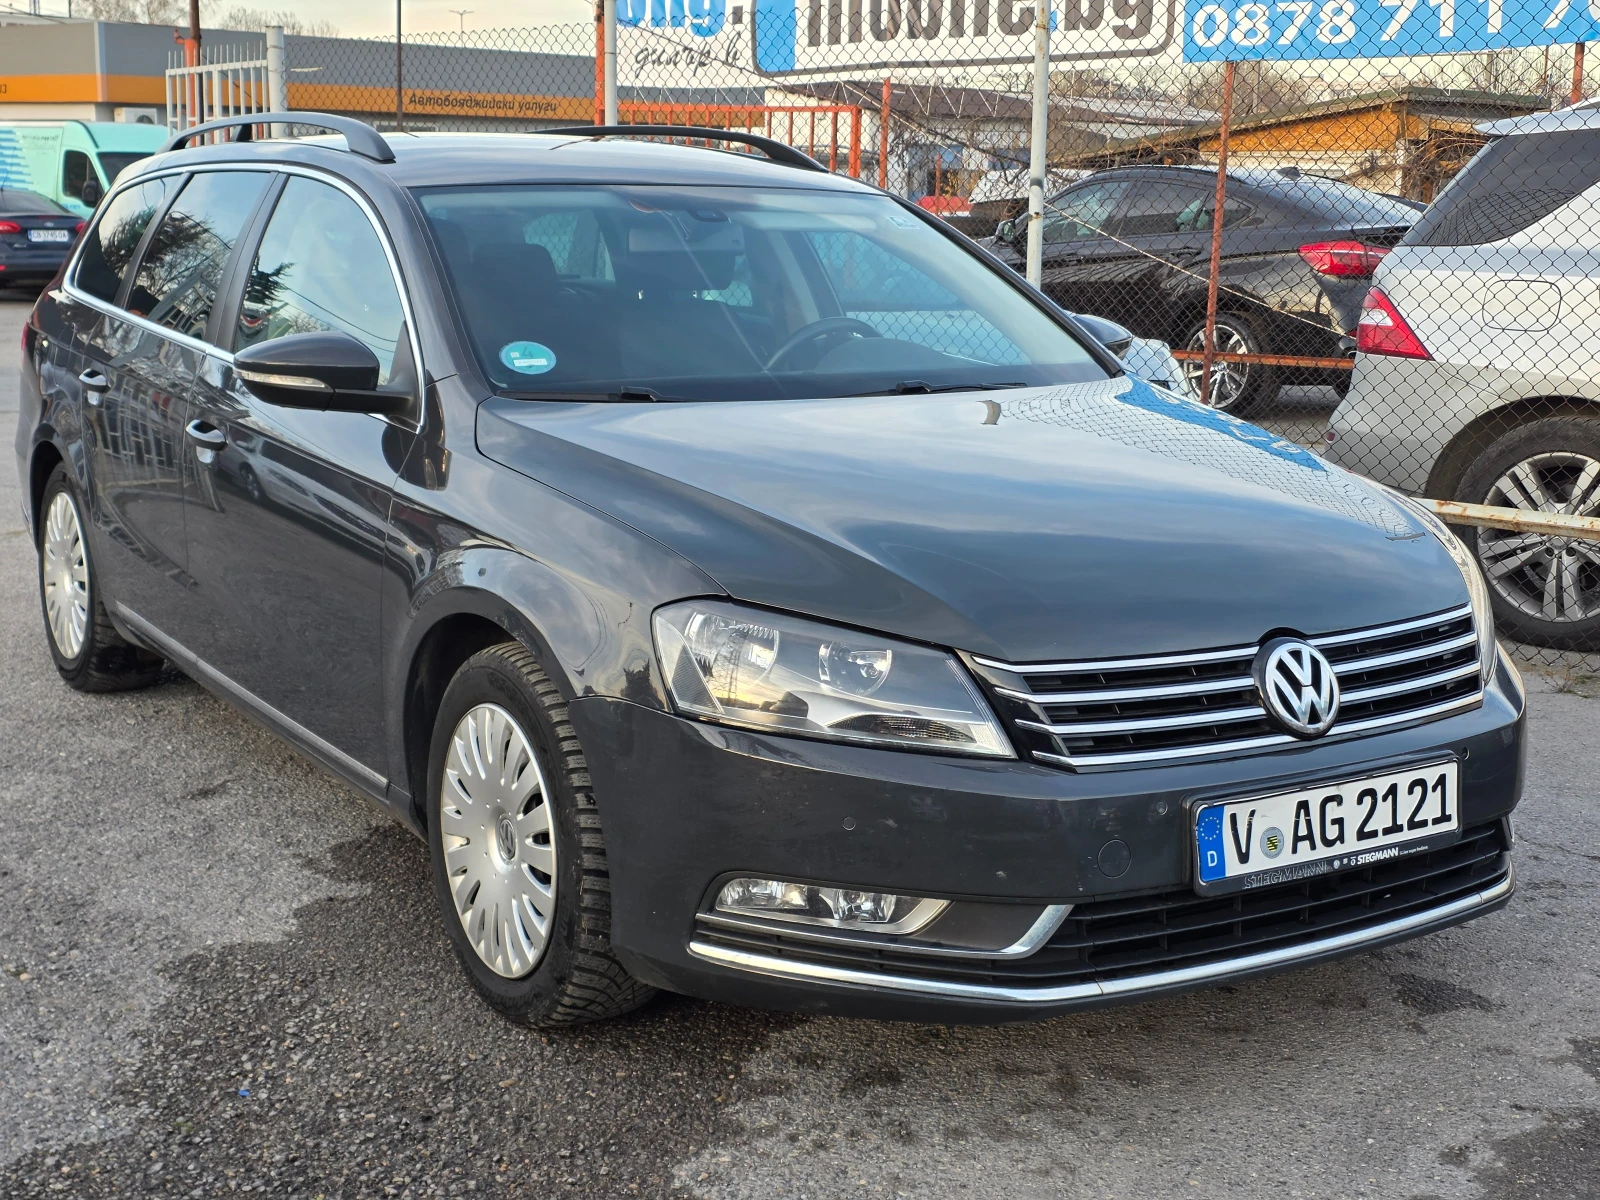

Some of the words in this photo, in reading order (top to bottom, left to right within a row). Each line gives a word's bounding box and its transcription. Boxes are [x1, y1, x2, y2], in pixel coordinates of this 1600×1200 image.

[1193, 0, 1356, 47] 0878
[1379, 0, 1502, 41] 711
[408, 92, 515, 110] Автобояджийски
[518, 100, 558, 113] услуги
[1229, 809, 1256, 865] V
[1291, 794, 1345, 855] AG
[1356, 773, 1452, 841] 2121
[1207, 851, 1218, 867] D
[1243, 860, 1327, 889] STEGMANN
[1357, 846, 1399, 865] STEGMANN
